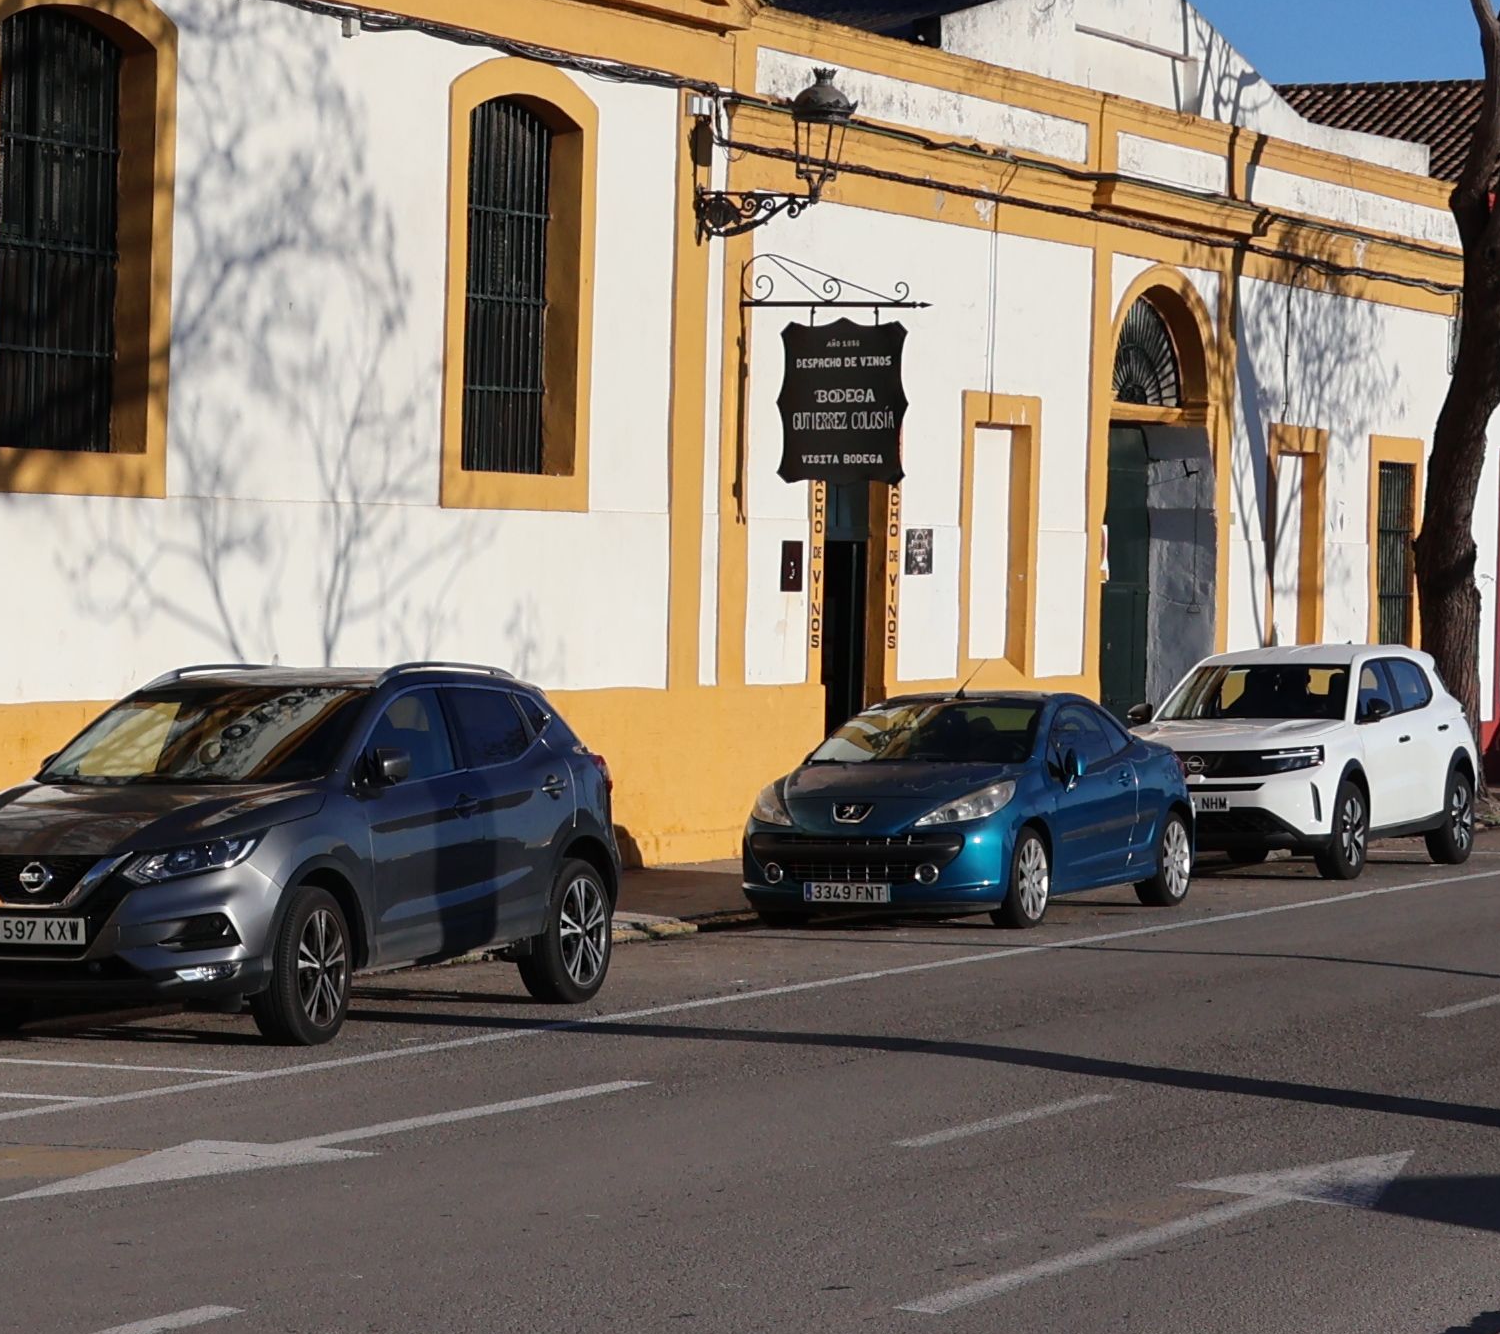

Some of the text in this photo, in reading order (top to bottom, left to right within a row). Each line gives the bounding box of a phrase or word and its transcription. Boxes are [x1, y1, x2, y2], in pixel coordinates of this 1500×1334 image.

[796, 355, 892, 369] DESPACHO DE VINOS
[814, 388, 876, 403] BODEGA
[850, 405, 895, 429] COLOSÍA
[801, 453, 883, 464] VISITA BODEGA
[813, 546, 822, 559] DE
[889, 550, 898, 562] DE
[811, 570, 822, 649] VINOS
[887, 574, 898, 649] VINOS
[1202, 797, 1227, 810] NHM
[814, 885, 883, 901] 3349 FNT
[44, 920, 79, 941] KXW
